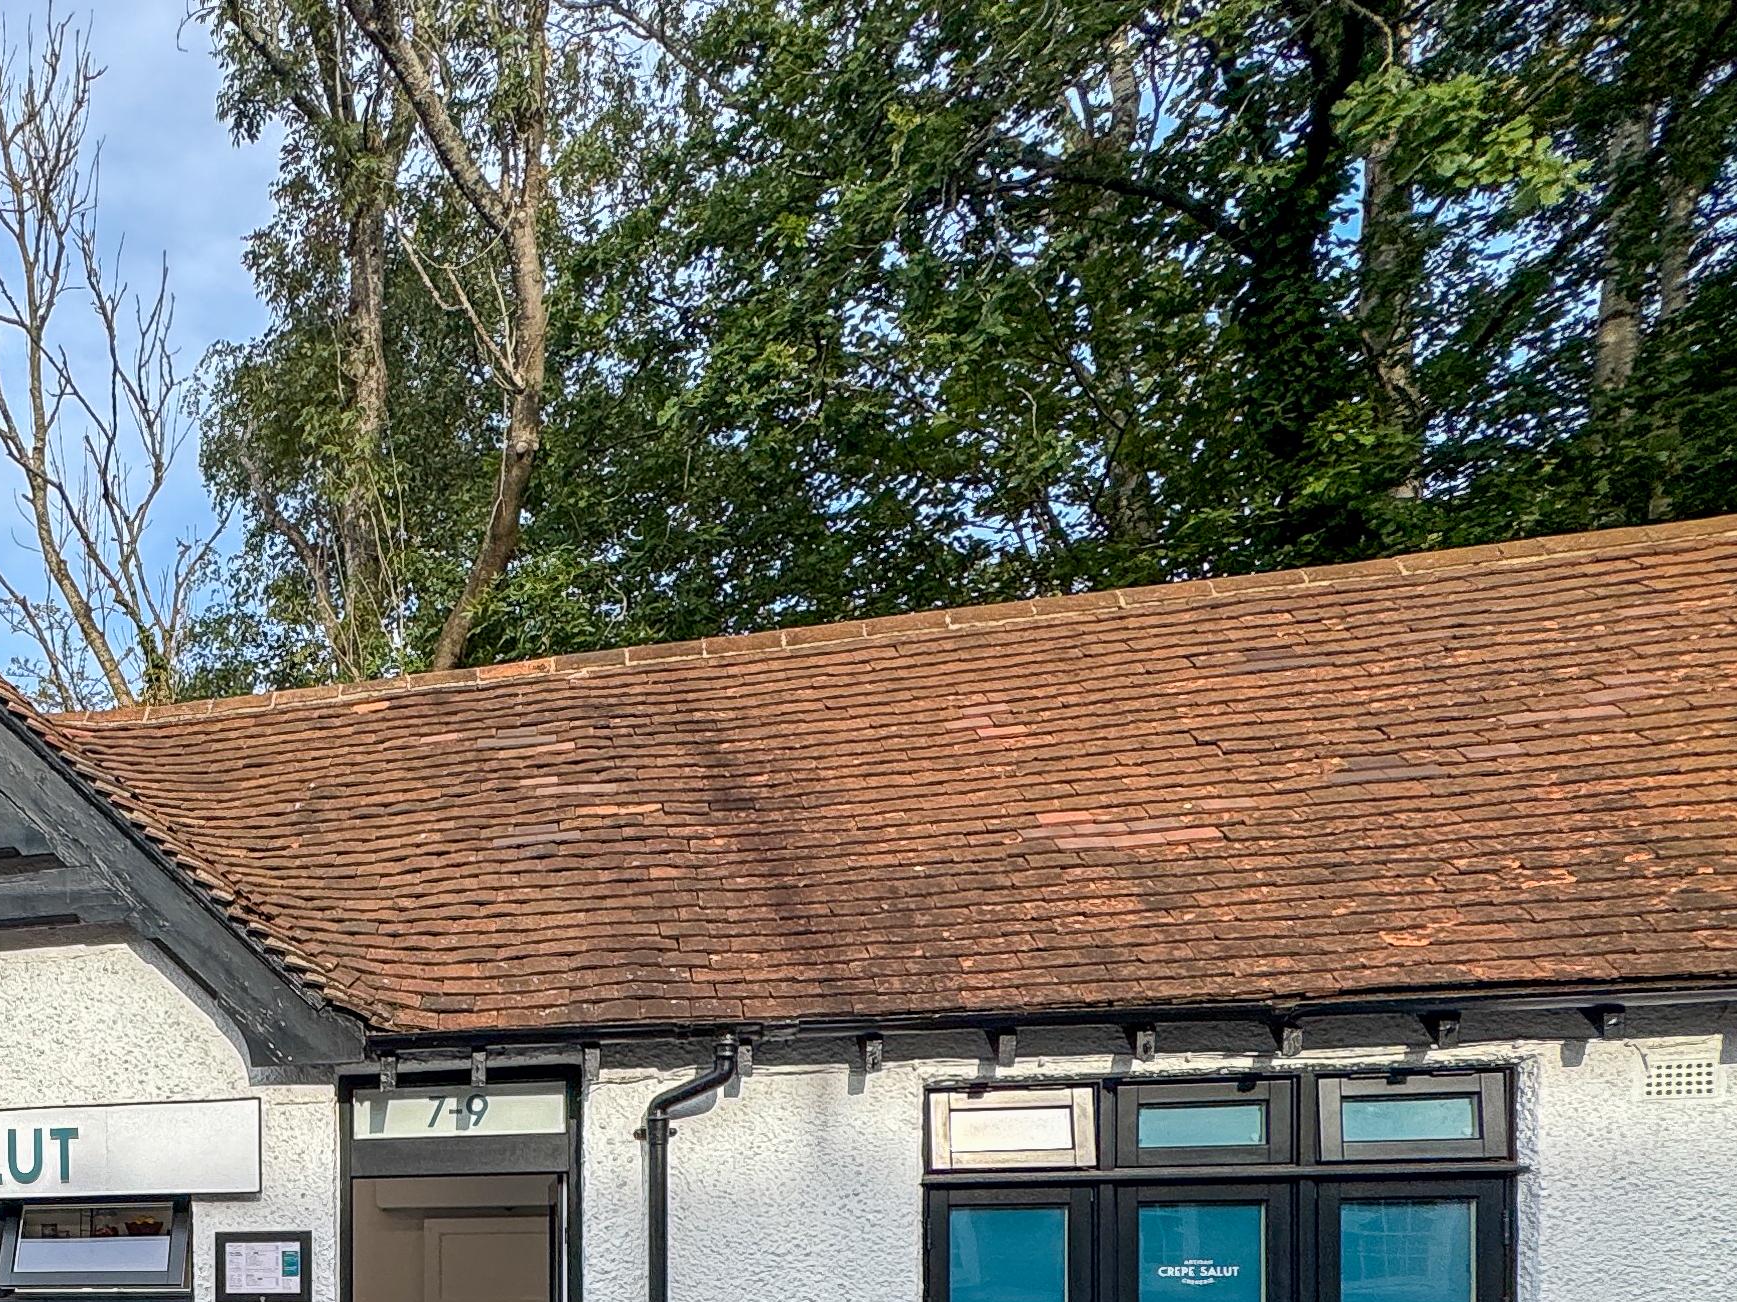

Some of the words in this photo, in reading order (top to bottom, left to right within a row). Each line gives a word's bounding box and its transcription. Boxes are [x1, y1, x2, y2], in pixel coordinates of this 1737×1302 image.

[427, 1093, 489, 1128] 7-9
[1158, 1266, 1196, 1277] CREPE
[1199, 1266, 1240, 1277] SALUT
